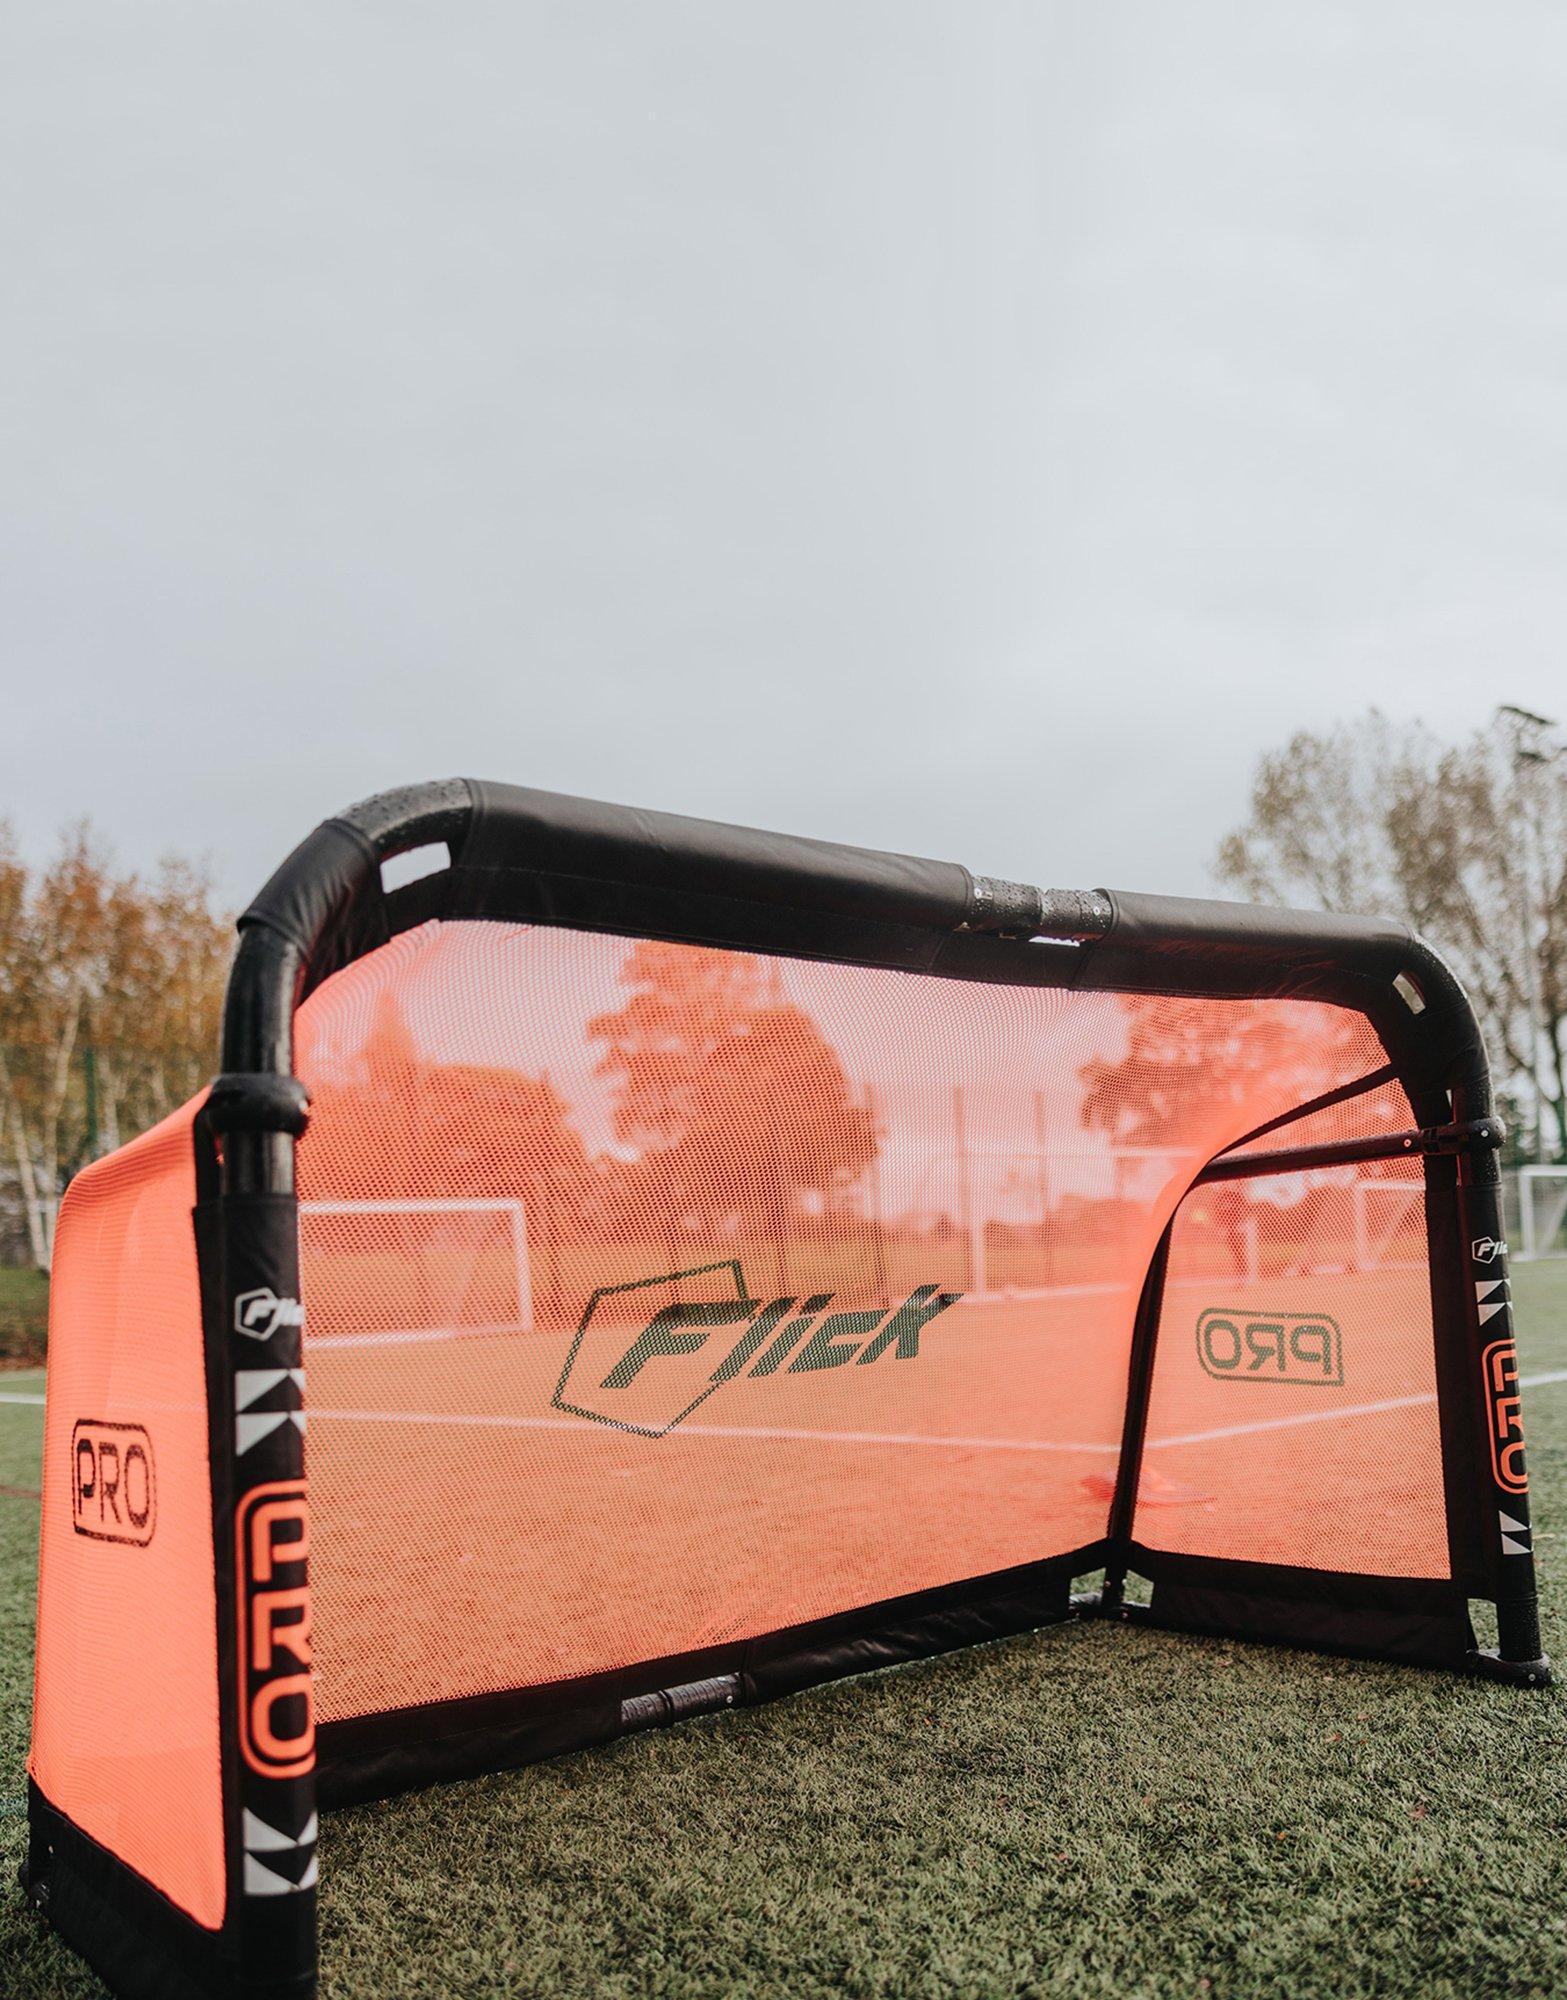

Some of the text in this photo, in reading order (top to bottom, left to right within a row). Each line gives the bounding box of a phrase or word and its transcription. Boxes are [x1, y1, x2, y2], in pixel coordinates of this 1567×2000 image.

[1477, 1241, 1508, 1257] Flic
[243, 1297, 304, 1326] Flic
[600, 1284, 964, 1389] Flick
[77, 1438, 150, 1529] PRO
[252, 1499, 315, 1760] PRO
